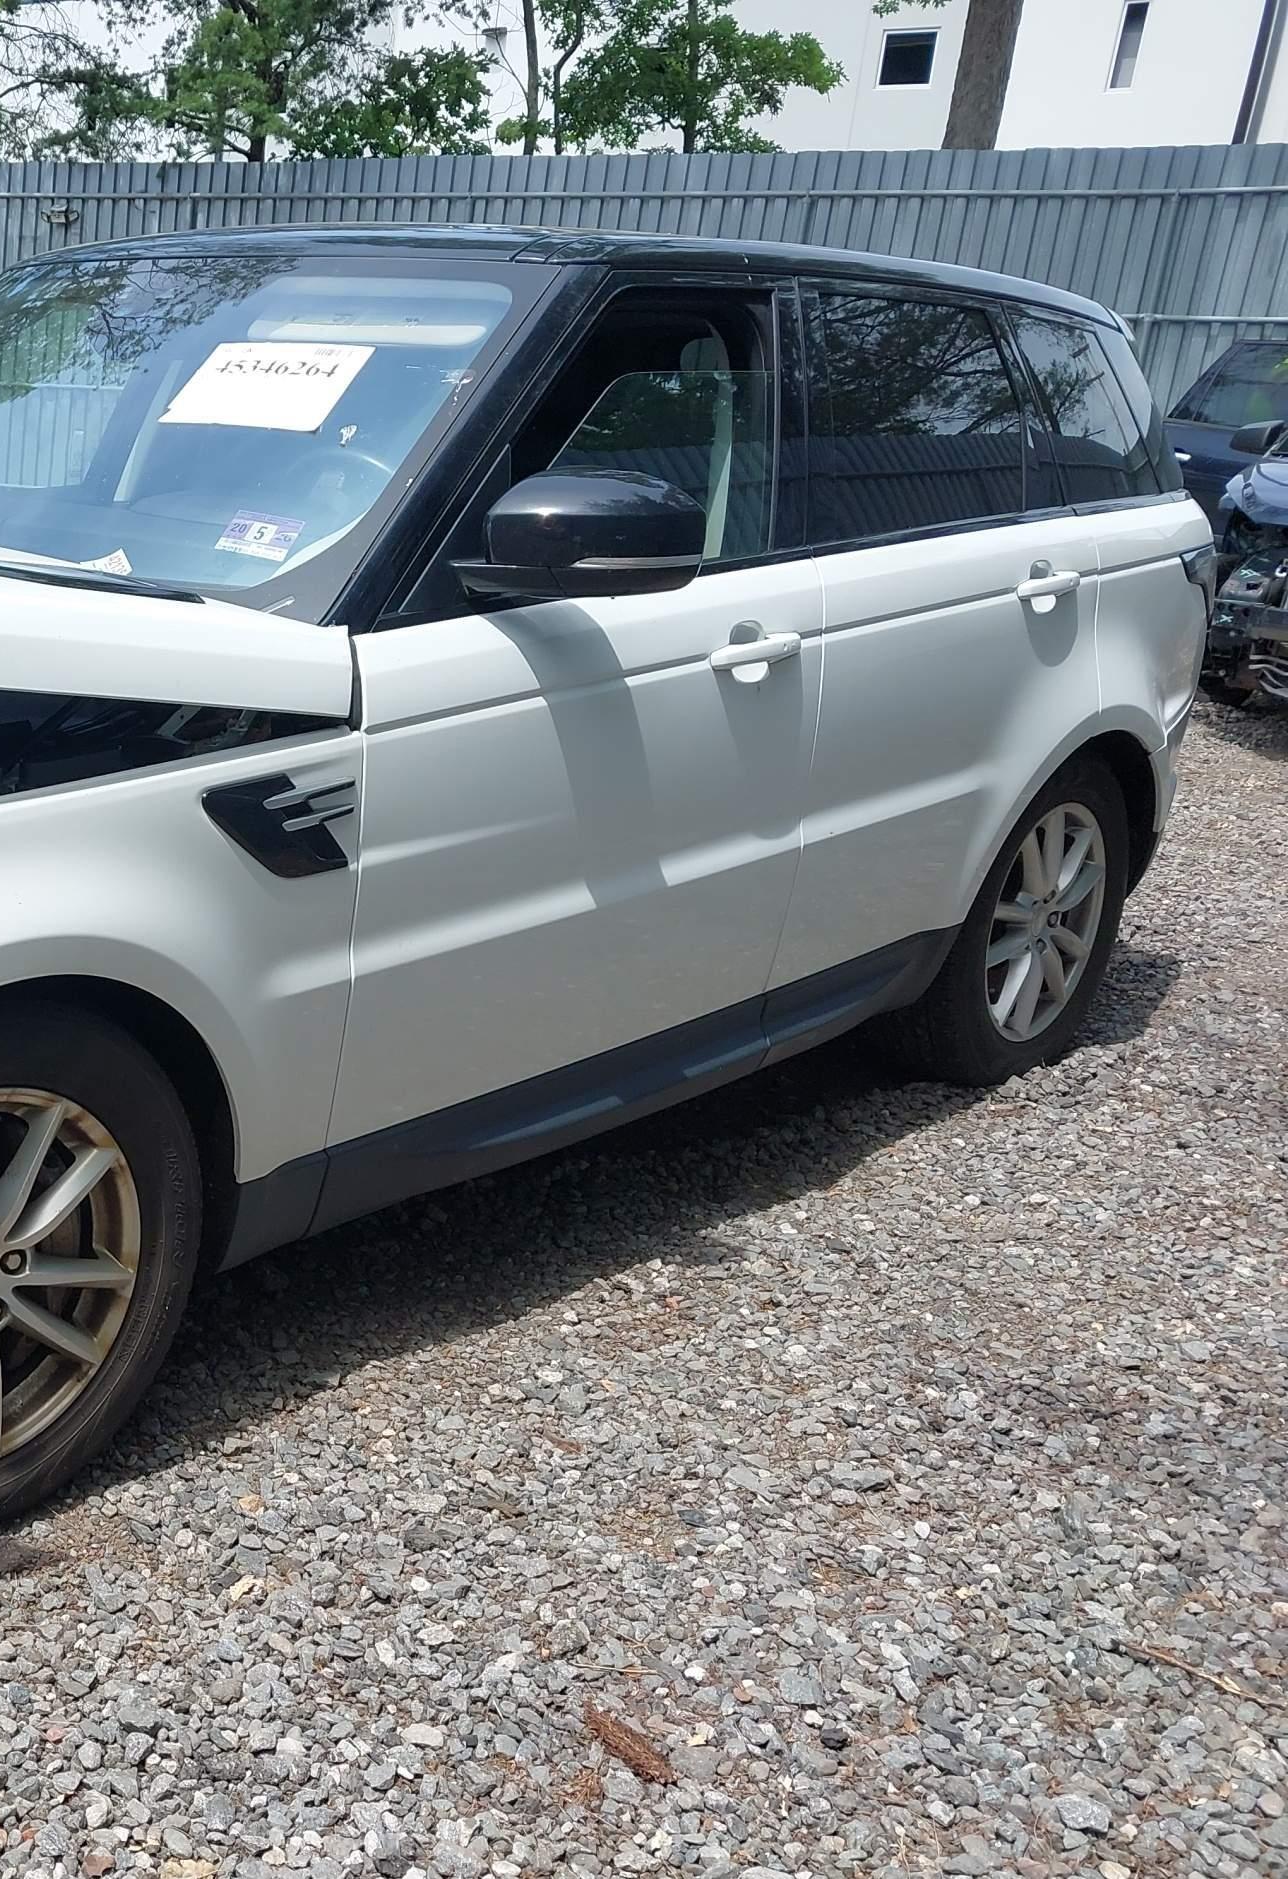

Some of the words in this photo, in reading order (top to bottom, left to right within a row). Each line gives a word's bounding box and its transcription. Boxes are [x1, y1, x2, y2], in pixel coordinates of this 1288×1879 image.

[215, 360, 340, 378] 45346264
[230, 522, 248, 534] 20
[253, 525, 268, 541] 5
